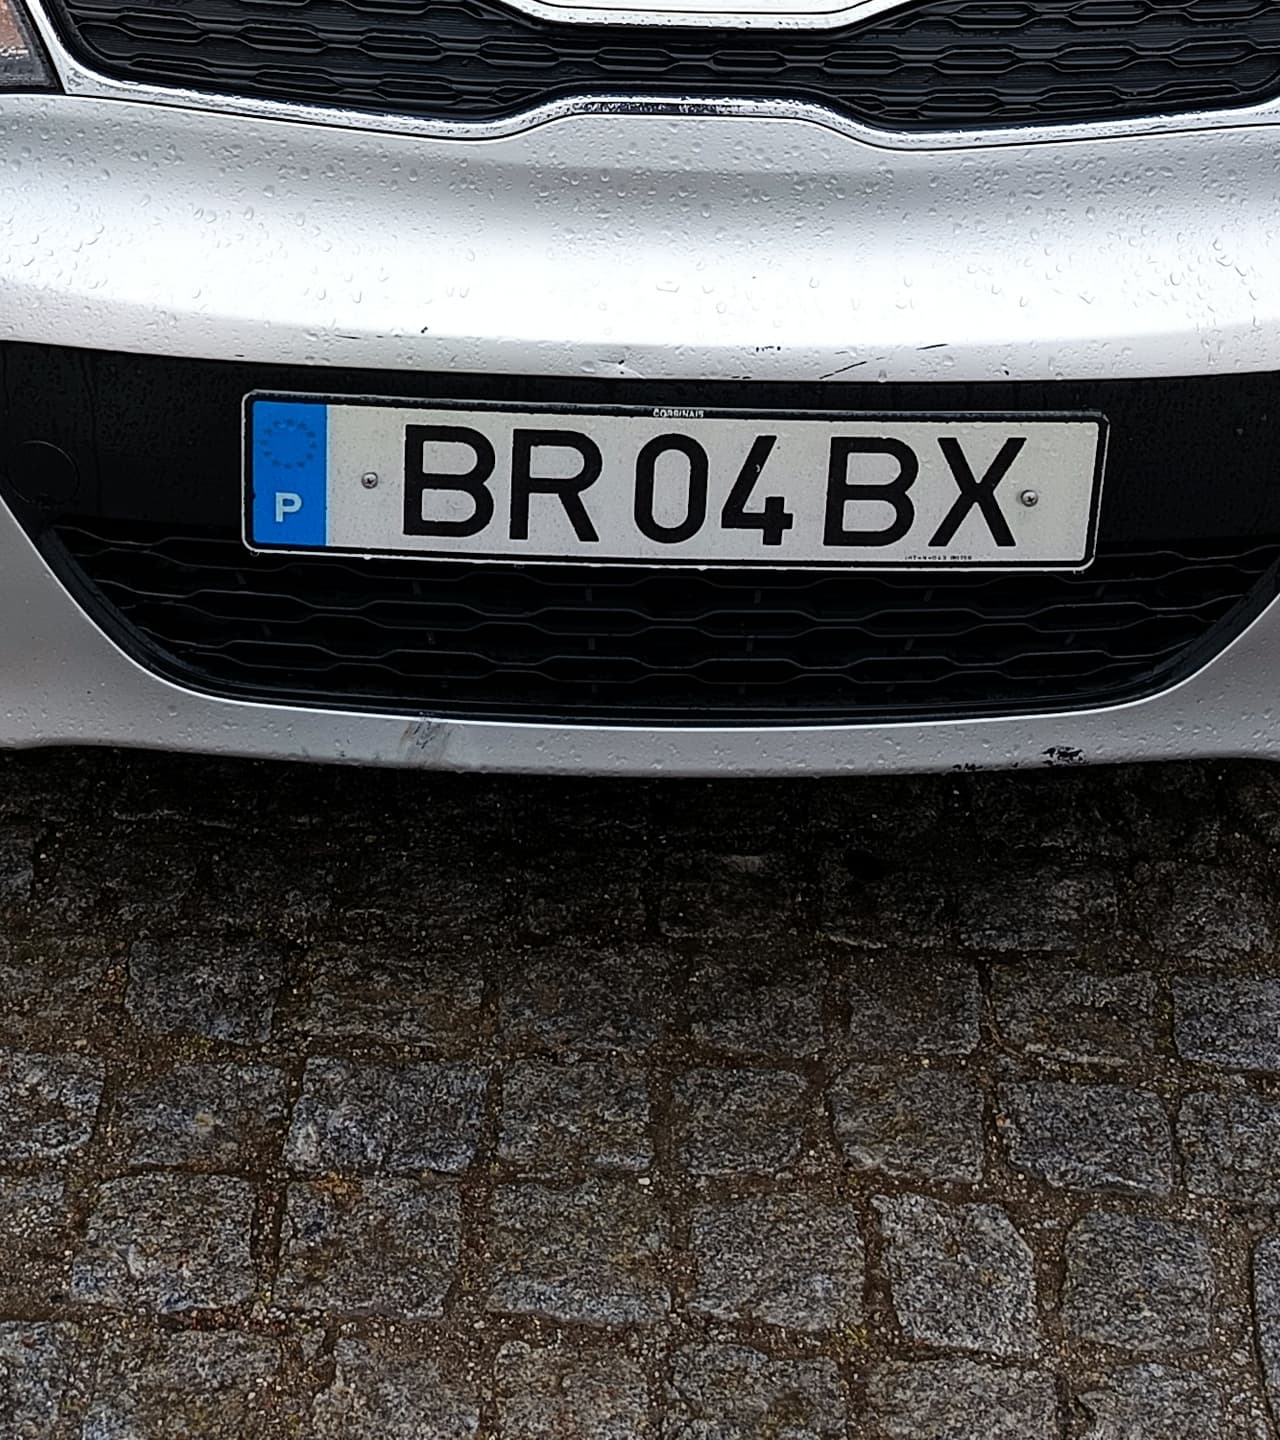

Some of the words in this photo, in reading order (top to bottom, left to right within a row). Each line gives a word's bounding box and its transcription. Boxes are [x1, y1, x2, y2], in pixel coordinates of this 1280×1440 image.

[402, 423, 604, 543] BR
[633, 432, 794, 546] 04
[822, 435, 1028, 548] BX
